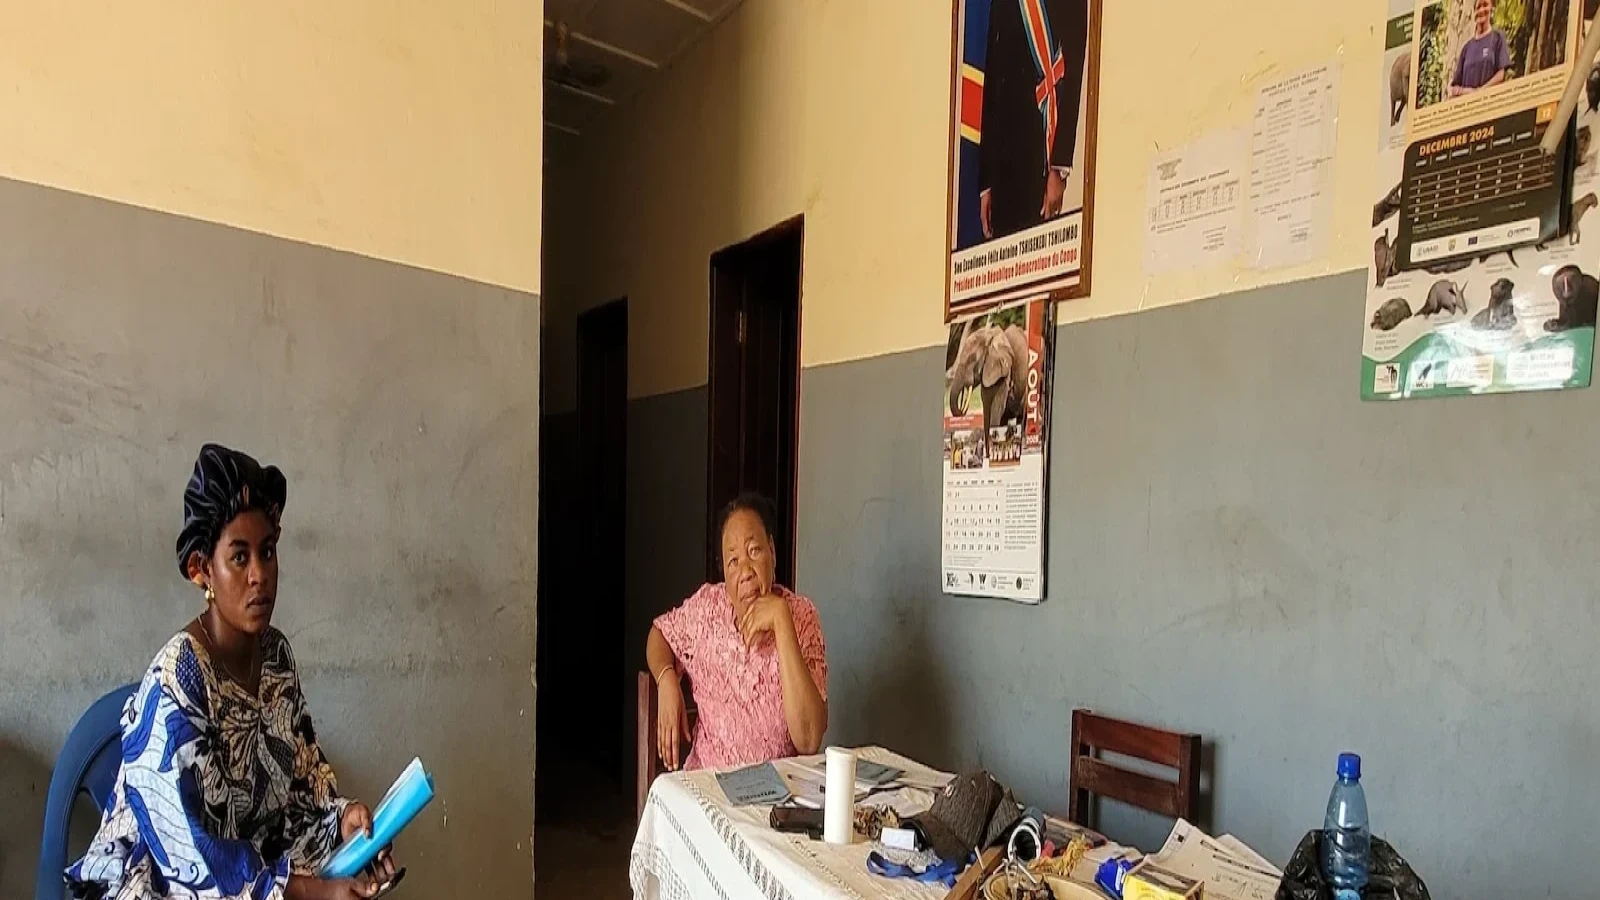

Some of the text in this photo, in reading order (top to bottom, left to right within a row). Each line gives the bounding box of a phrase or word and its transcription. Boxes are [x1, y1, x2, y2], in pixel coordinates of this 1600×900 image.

[1419, 133, 1468, 156] DECEMBRE
[1469, 125, 1495, 142] 2024
[954, 247, 1078, 294] Président de la République Démocratique du Congo
[962, 254, 987, 272] Excellence
[987, 250, 999, 265] Félix
[999, 244, 1018, 260] Antoine
[1019, 232, 1048, 256] TSHISEKEDI
[1048, 223, 1078, 247] TSHILOMBO
